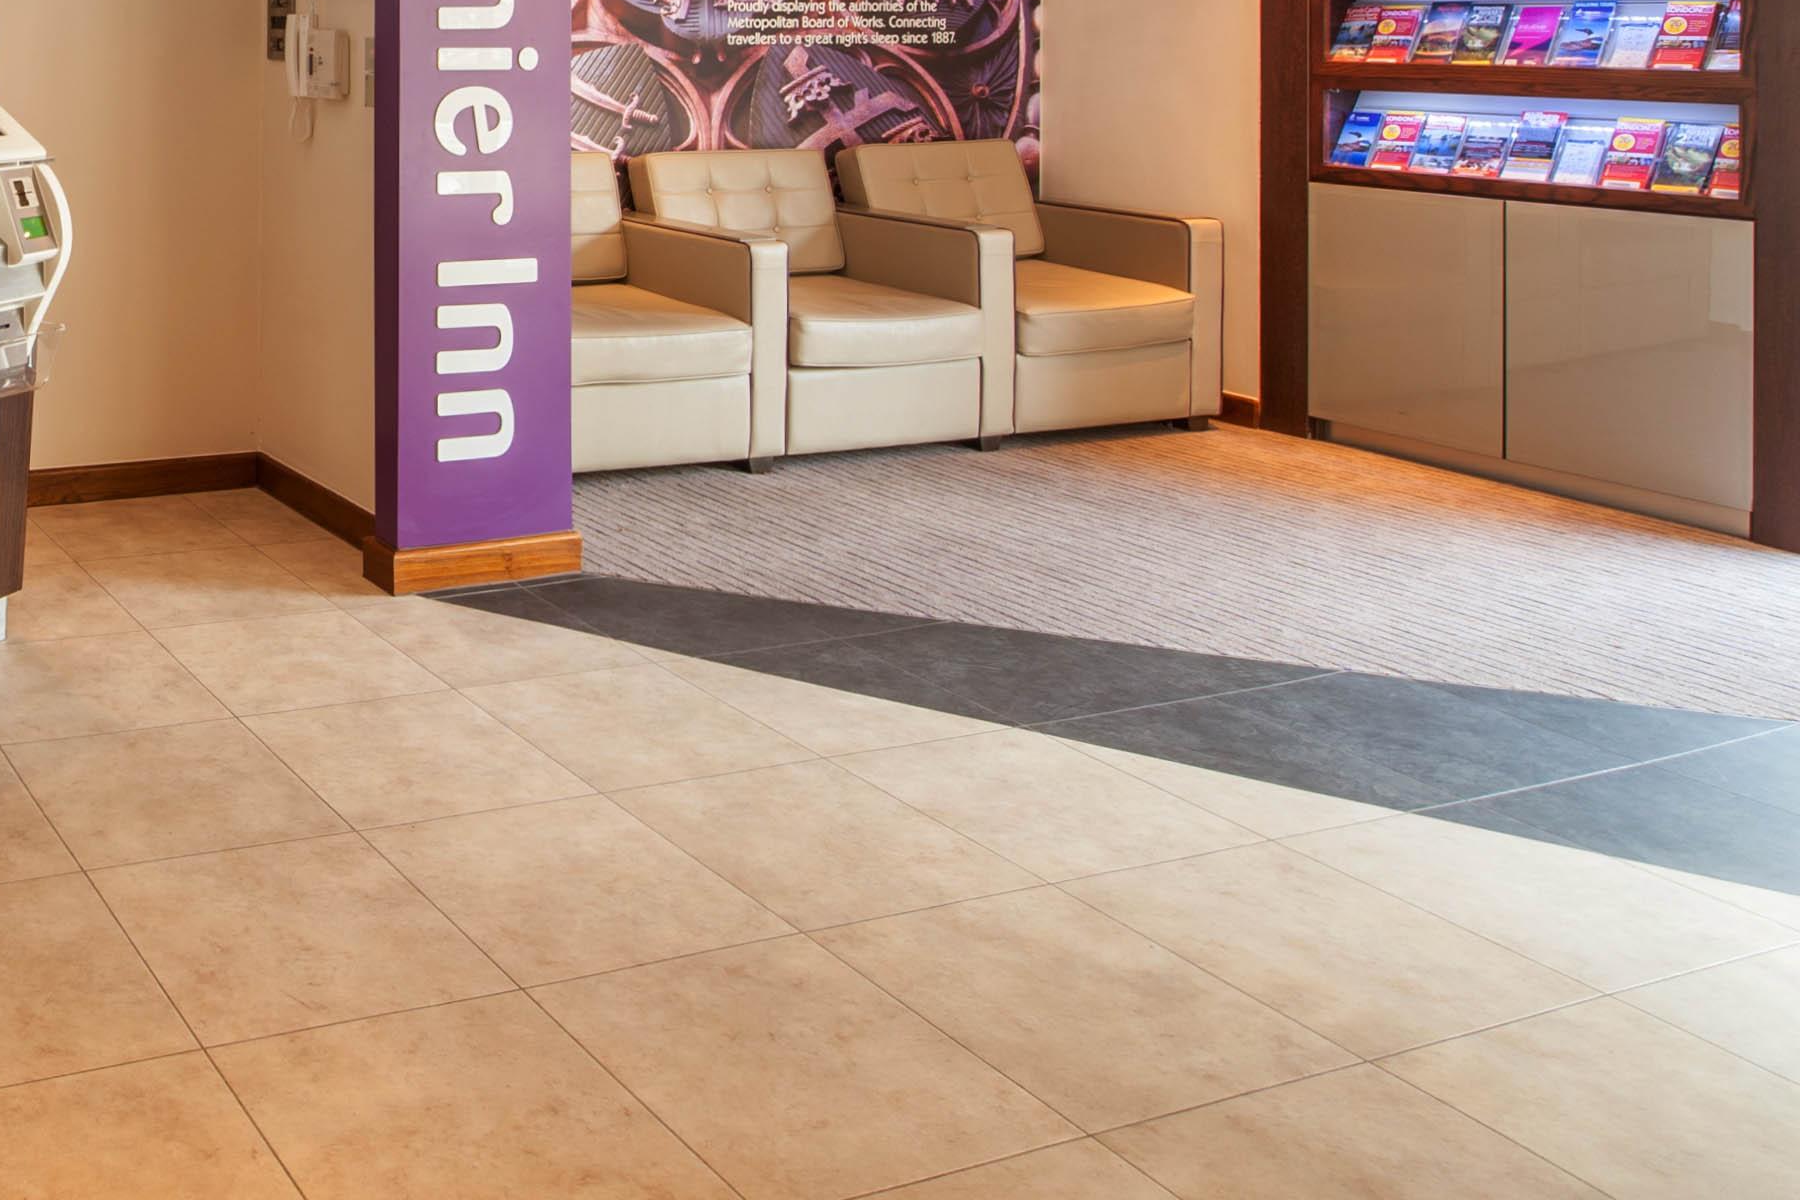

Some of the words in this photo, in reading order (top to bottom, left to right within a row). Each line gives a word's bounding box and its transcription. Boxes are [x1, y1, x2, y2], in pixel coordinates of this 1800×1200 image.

[728, 0, 769, 14] Proudly
[771, 0, 825, 15] displaying
[828, 0, 846, 12] the
[848, 0, 904, 12] authorities
[906, 0, 919, 12] of
[920, 0, 937, 12] the
[728, 16, 799, 29] Metropolitan
[802, 16, 834, 29] Board
[837, 15, 851, 29] of
[852, 16, 886, 29] Works.
[888, 16, 947, 31] Connecting
[727, 33, 777, 45] travellers
[779, 34, 793, 45] to
[794, 36, 802, 45] a
[804, 34, 833, 48] great
[835, 32, 868, 46] night's
[870, 32, 900, 47] sleep
[902, 33, 929, 44] since
[931, 32, 957, 44] 1887.
[435, 256, 539, 465] Inn
